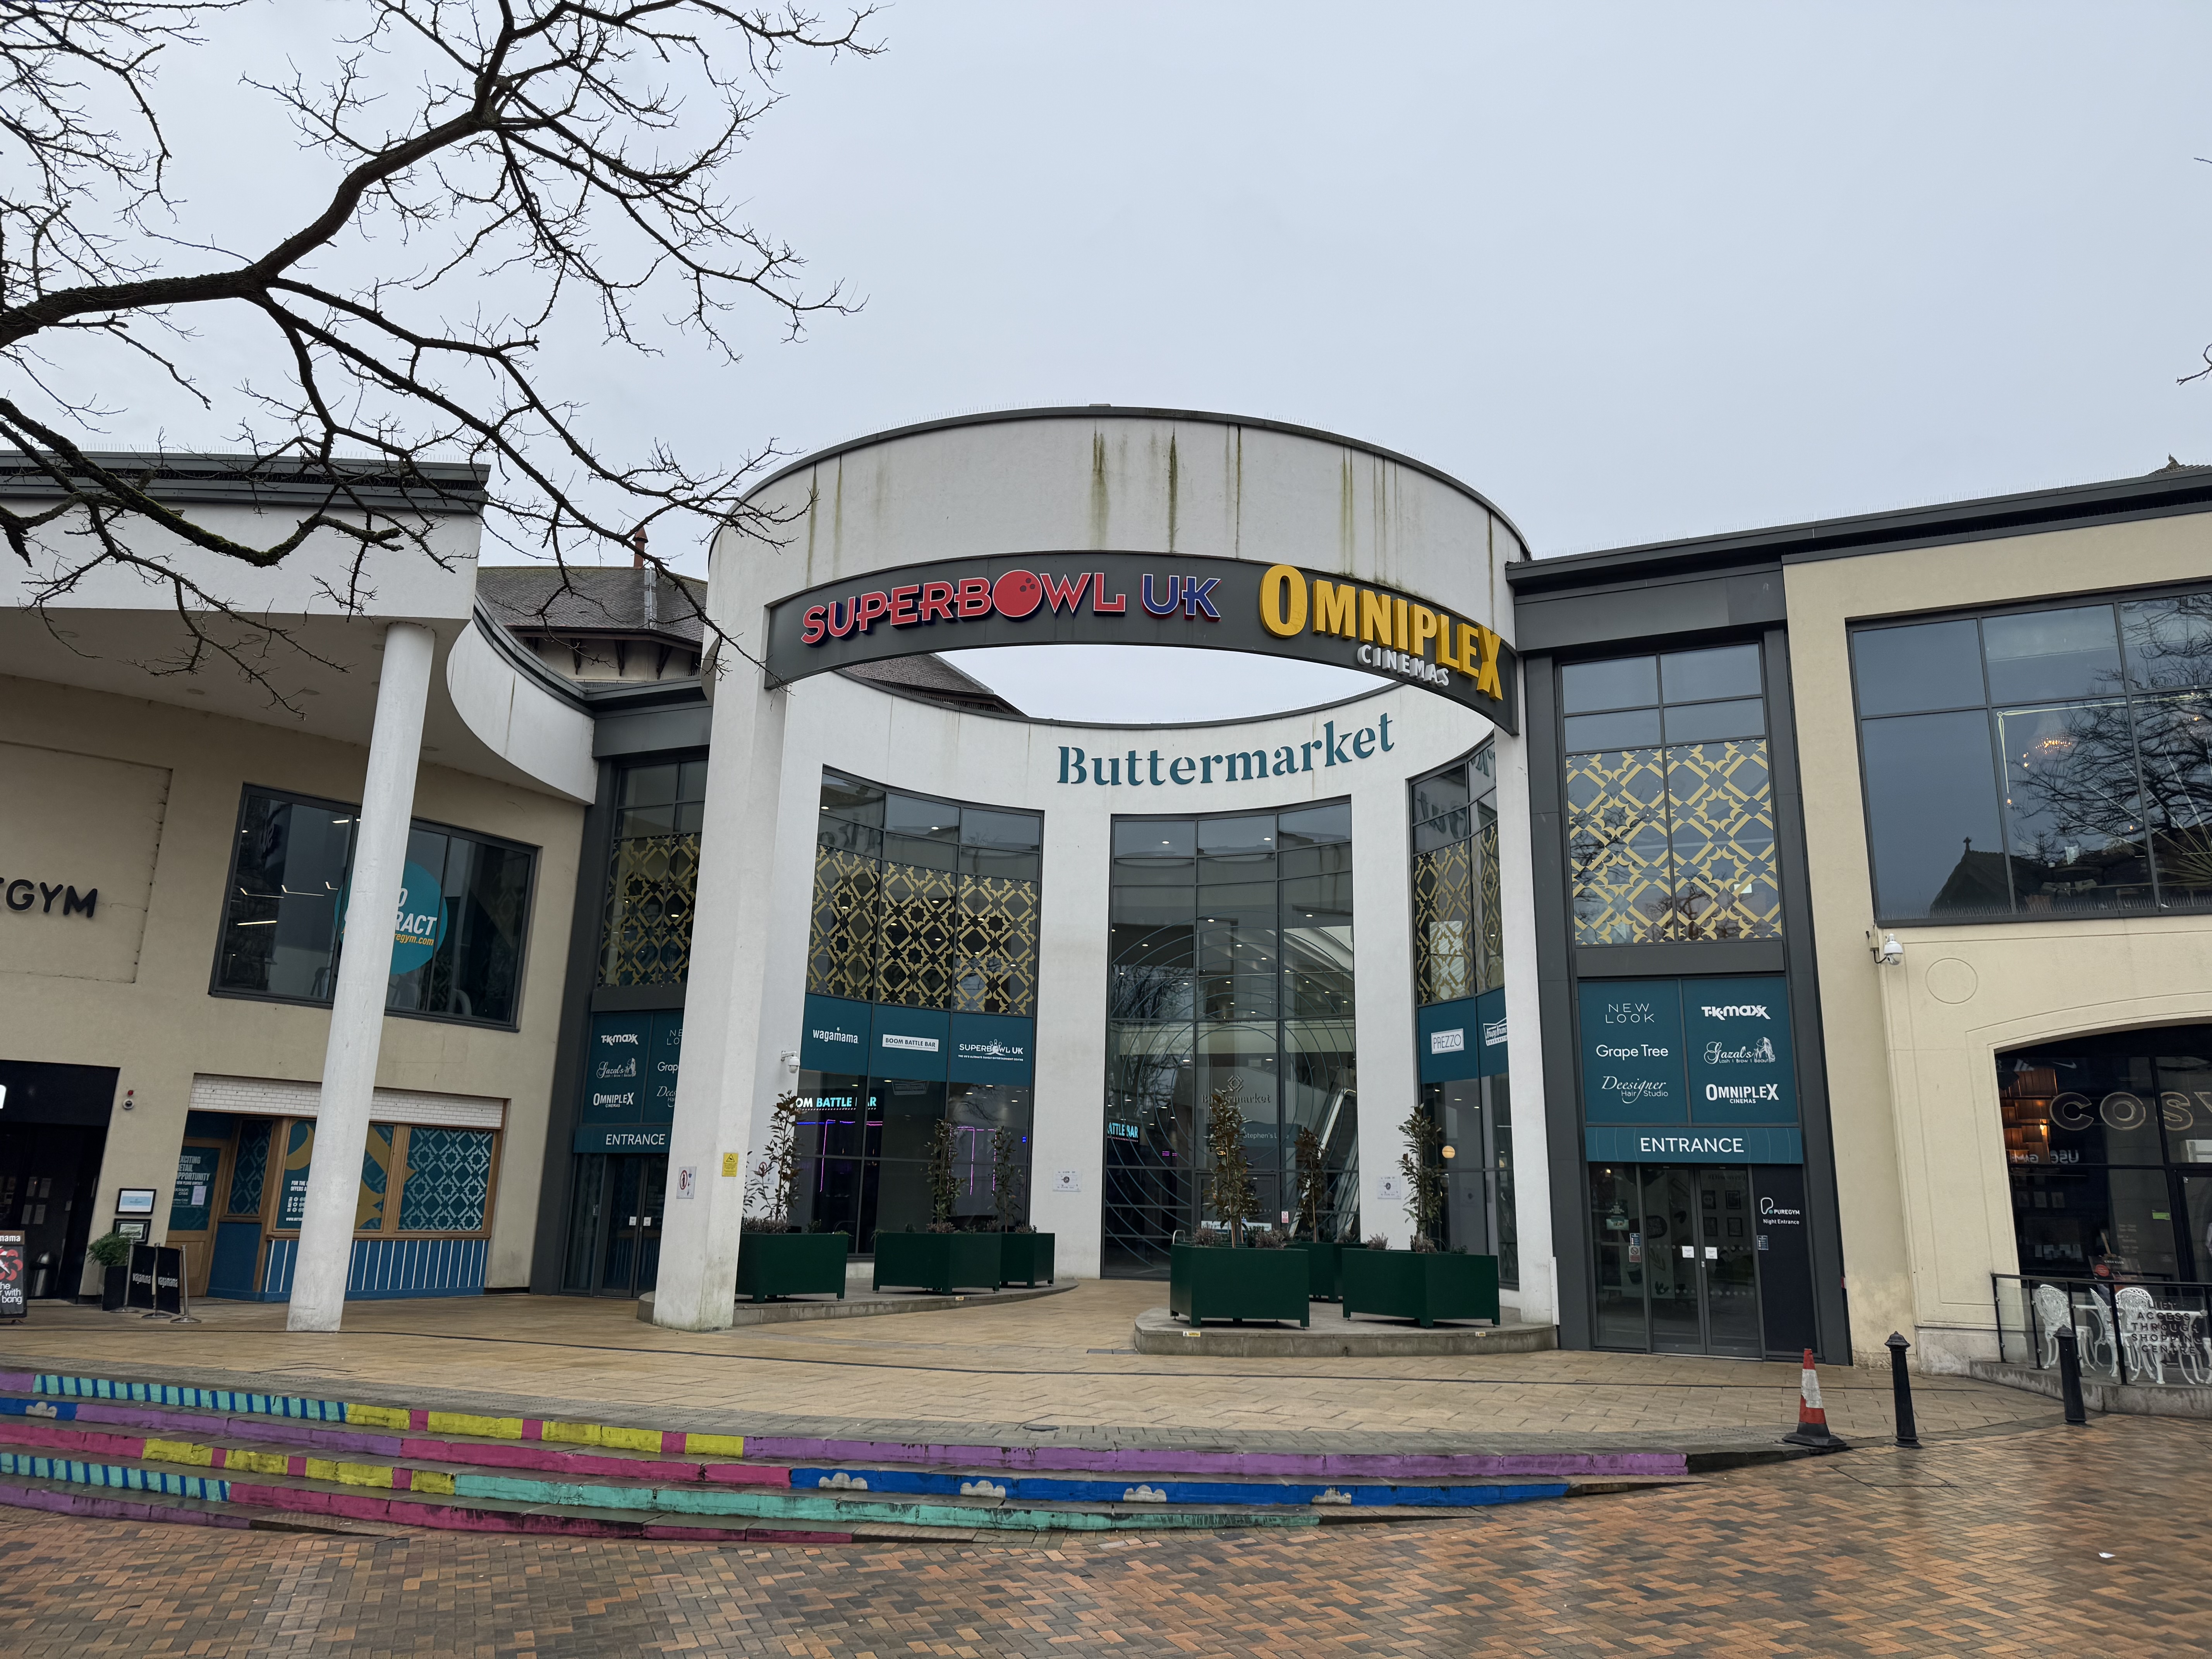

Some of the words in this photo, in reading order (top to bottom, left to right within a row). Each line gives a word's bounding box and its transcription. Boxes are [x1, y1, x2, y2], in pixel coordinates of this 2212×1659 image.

[800, 568, 1127, 647] SUPERBOWL
[1140, 573, 1222, 621] UK
[1259, 564, 1503, 701] OMNIPLEX
[1357, 644, 1449, 688] CINEMAS
[1057, 712, 1395, 786] Buttermarket
[0, 877, 98, 918] GYM
[1608, 1003, 1649, 1013] NEW
[1605, 1013, 1655, 1024] LOOK
[670, 1029, 683, 1037] NE
[813, 1029, 859, 1044] wagamama
[1433, 1034, 1462, 1049] PREZZO
[1596, 1044, 1638, 1061] Grape
[1640, 1044, 1669, 1057] Tree
[658, 1061, 678, 1073] Grap
[1601, 1076, 1666, 1104] Deesigner
[1705, 1084, 1779, 1101] OMNIPLEX
[593, 1092, 635, 1106] OMNIPLEX
[816, 1097, 852, 1107] BATTLE
[1108, 1122, 1125, 1136] ATTLE
[1127, 1125, 1138, 1138] BAR
[605, 1133, 666, 1145] ENTRANCE
[1640, 1137, 1744, 1153] ENTRANCE
[180, 1155, 201, 1164] XCITING
[179, 1164, 193, 1172] ETAIL
[178, 1172, 210, 1181] PPORTUNITY
[2, 1296, 22, 1305] bang
[2137, 1312, 2191, 1322] ACCESS
[2131, 1334, 2203, 1345] SHOPPING
[2141, 1345, 2196, 1355] CENTRE
